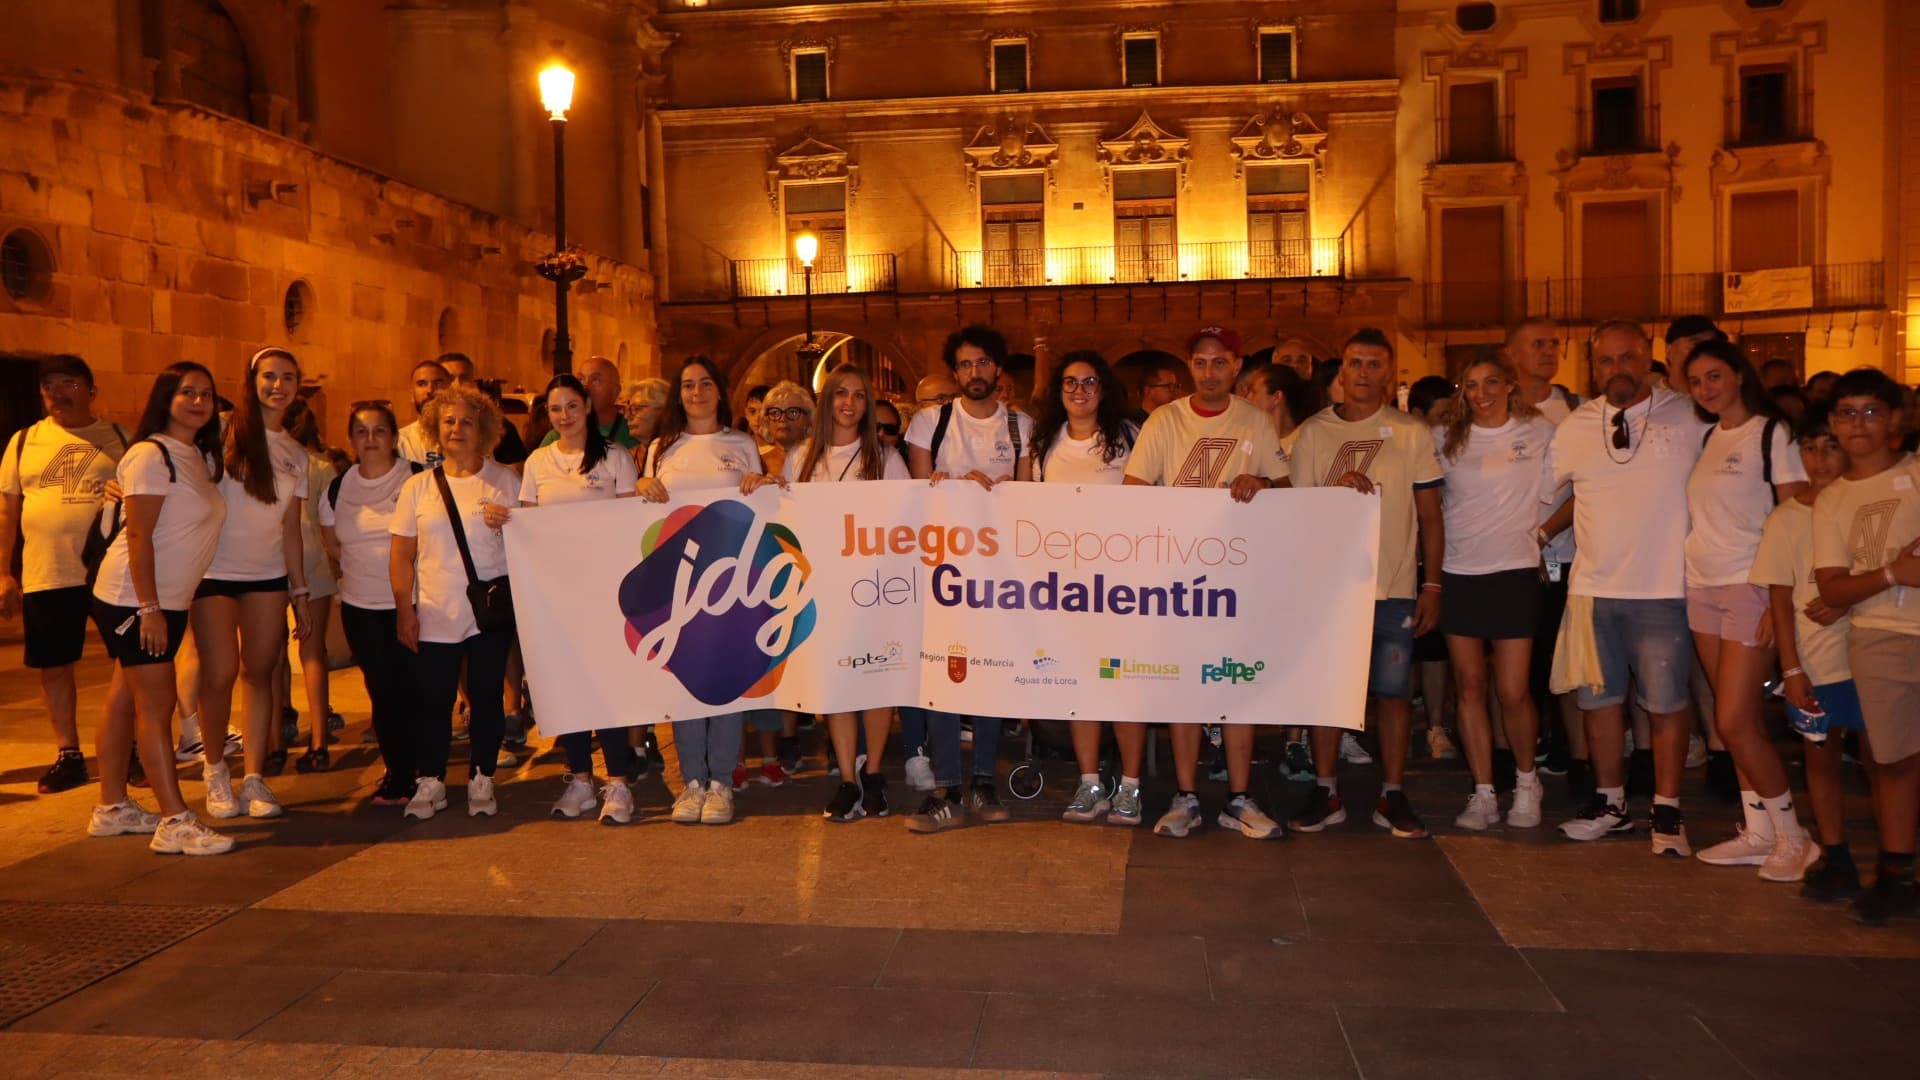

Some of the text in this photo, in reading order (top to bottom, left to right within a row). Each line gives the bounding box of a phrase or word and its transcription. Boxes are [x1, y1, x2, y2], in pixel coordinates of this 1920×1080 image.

[841, 514, 1248, 569] Juegos Deportivos
[635, 506, 814, 669] jdg
[850, 563, 1237, 618] del Guadalentín
[838, 652, 887, 669] dpts
[970, 657, 981, 666] de
[983, 658, 1014, 668] Murcia
[1123, 659, 1180, 674] Limusa
[1201, 657, 1256, 685] Felipe
[1014, 675, 1077, 686] Aguas de Lorca
